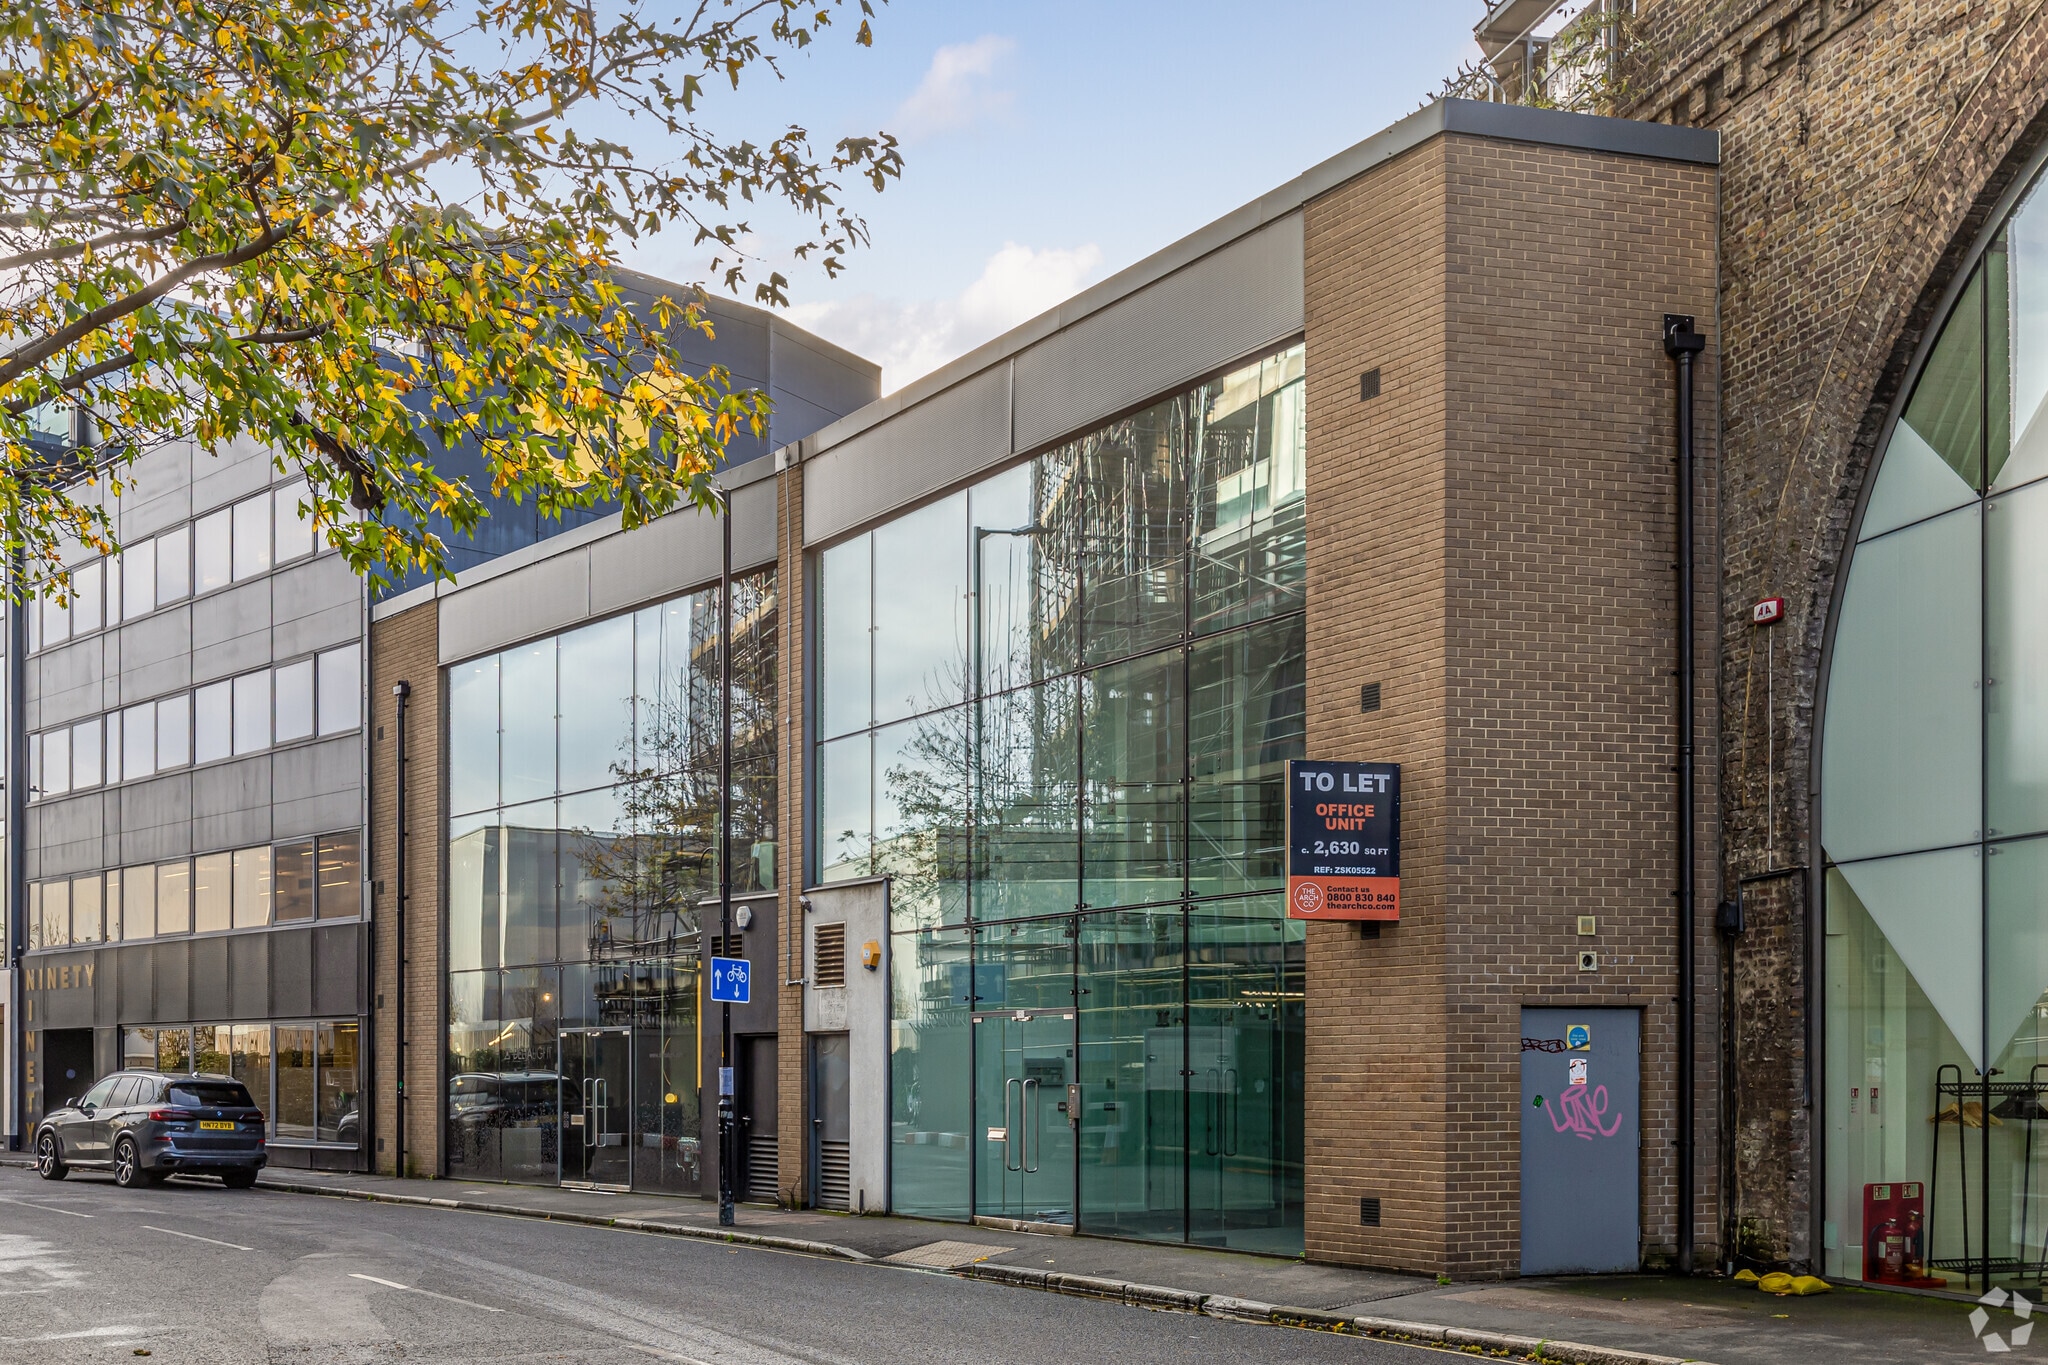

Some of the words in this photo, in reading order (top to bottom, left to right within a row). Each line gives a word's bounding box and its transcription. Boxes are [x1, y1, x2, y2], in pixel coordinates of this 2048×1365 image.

[1299, 772, 1335, 792] TO
[1343, 773, 1390, 793] LET
[1315, 803, 1375, 817] OFFICE
[1325, 818, 1366, 831] UNIT
[1314, 840, 1360, 857] 2,630
[1364, 848, 1376, 856] SQ
[1378, 848, 1388, 856] FT
[1314, 866, 1333, 874] REF:
[1334, 866, 1376, 875] ZSK05522
[1302, 887, 1316, 895] THE
[1327, 885, 1359, 893] Contact
[1327, 893, 1352, 902] 0800
[1355, 893, 1374, 902] 830
[1376, 894, 1395, 903] 840
[1327, 902, 1395, 910] thearchco.com
[25, 963, 96, 992] NINETY
